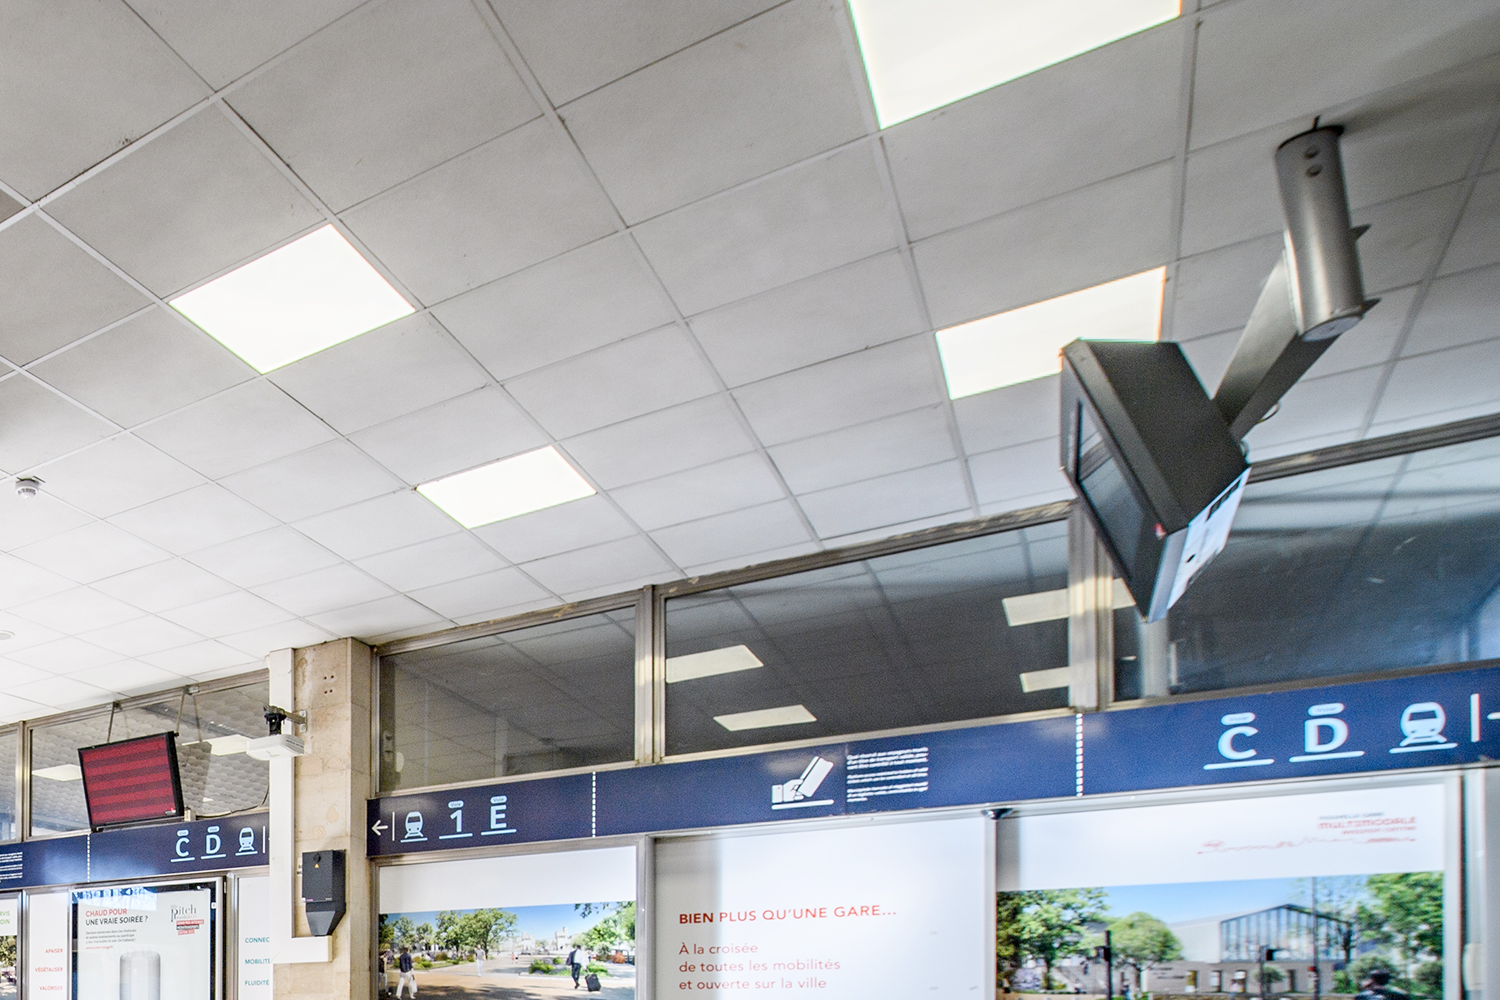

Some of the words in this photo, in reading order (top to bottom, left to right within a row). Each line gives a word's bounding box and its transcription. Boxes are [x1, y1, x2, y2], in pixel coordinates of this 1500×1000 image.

[1218, 726, 1258, 760] C
[1304, 717, 1349, 753] D
[450, 809, 462, 833] 1
[490, 804, 507, 829] E
[175, 837, 190, 858] C
[206, 834, 222, 854] D
[86, 910, 108, 918] CHAUD
[108, 908, 128, 916] POUR
[86, 918, 98, 926] UNE
[119, 915, 144, 924] SOIRÉE
[679, 912, 714, 924] BIEN
[719, 910, 757, 922] PLUS
[679, 942, 690, 955] À
[693, 944, 704, 955] la
[708, 942, 758, 954] croisée
[679, 961, 696, 972] de
[700, 962, 744, 972] toutes
[749, 960, 768, 972] les
[773, 958, 841, 971] mobilités
[679, 980, 692, 990] et
[696, 980, 750, 990] ouverte
[754, 980, 776, 990] sur
[781, 977, 793, 990] la
[798, 977, 827, 989] ville
